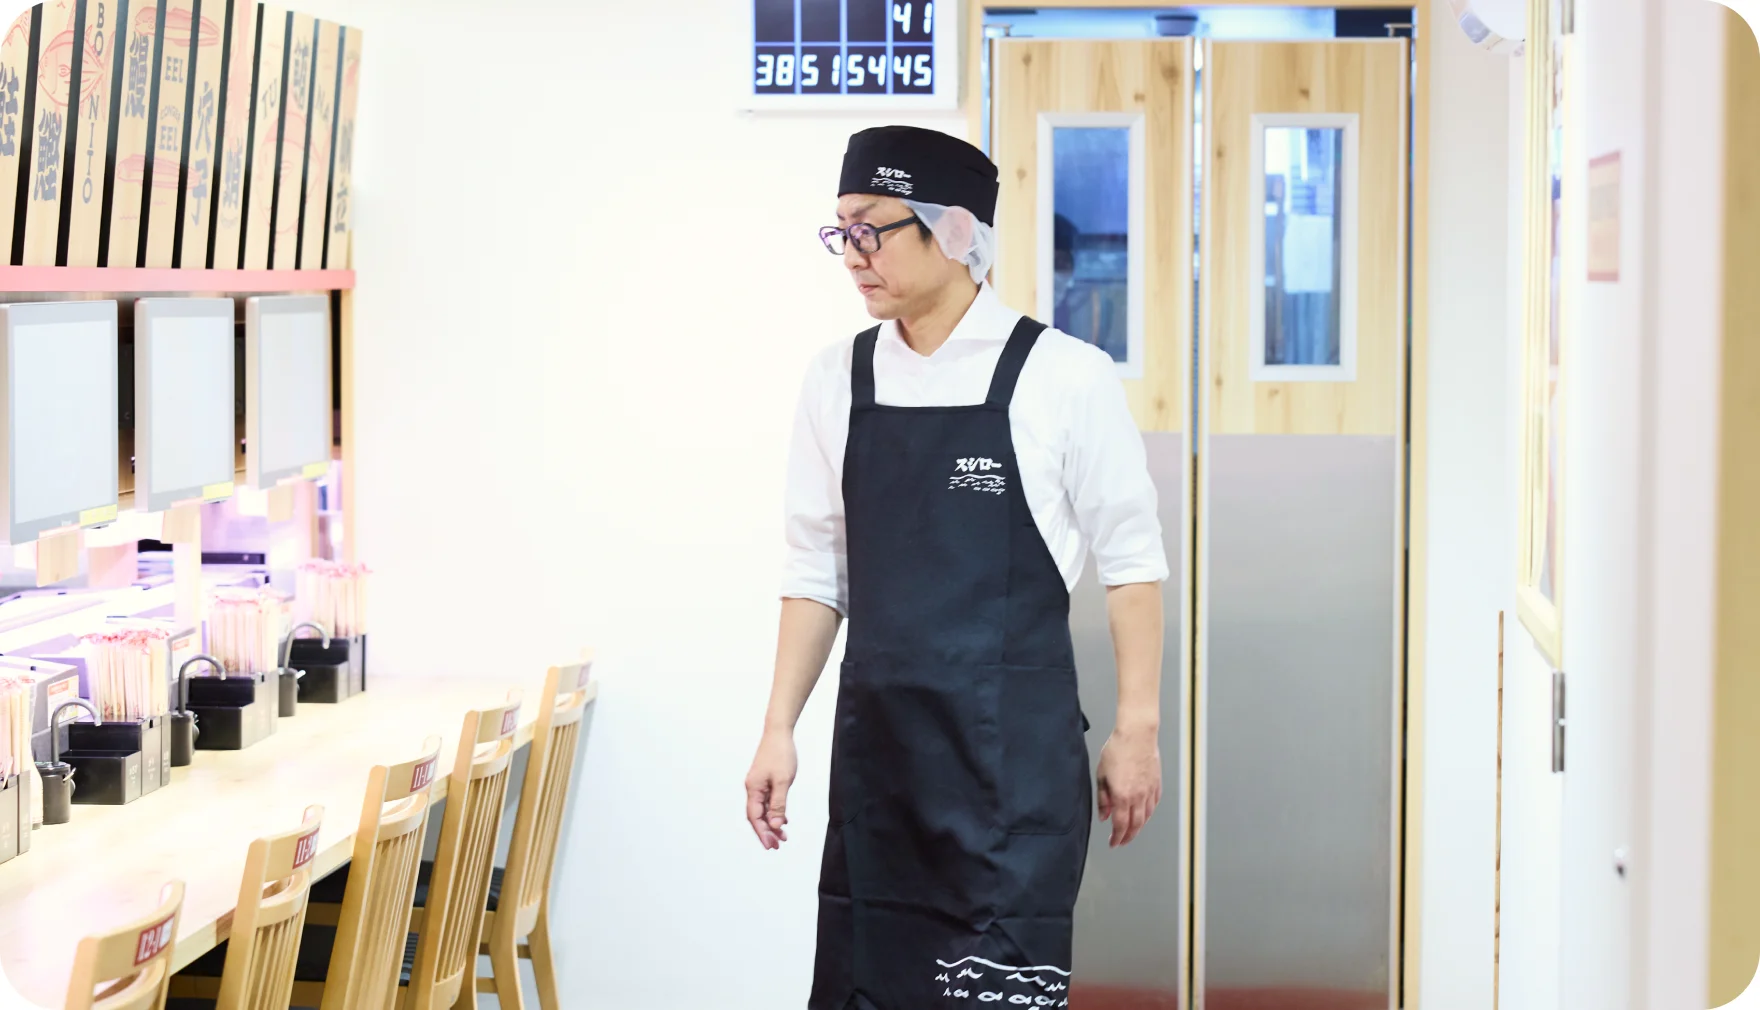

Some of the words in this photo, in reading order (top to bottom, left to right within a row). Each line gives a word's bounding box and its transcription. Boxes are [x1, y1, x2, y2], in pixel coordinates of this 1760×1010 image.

[893, 2, 933, 34] 41
[165, 55, 184, 84] EEL
[755, 54, 795, 87] 38
[800, 54, 841, 87] 51
[847, 54, 887, 87] 54
[893, 54, 932, 87] 45
[159, 125, 178, 152] EEL
[875, 166, 912, 178] スシロー
[954, 457, 1002, 472] スシロー
